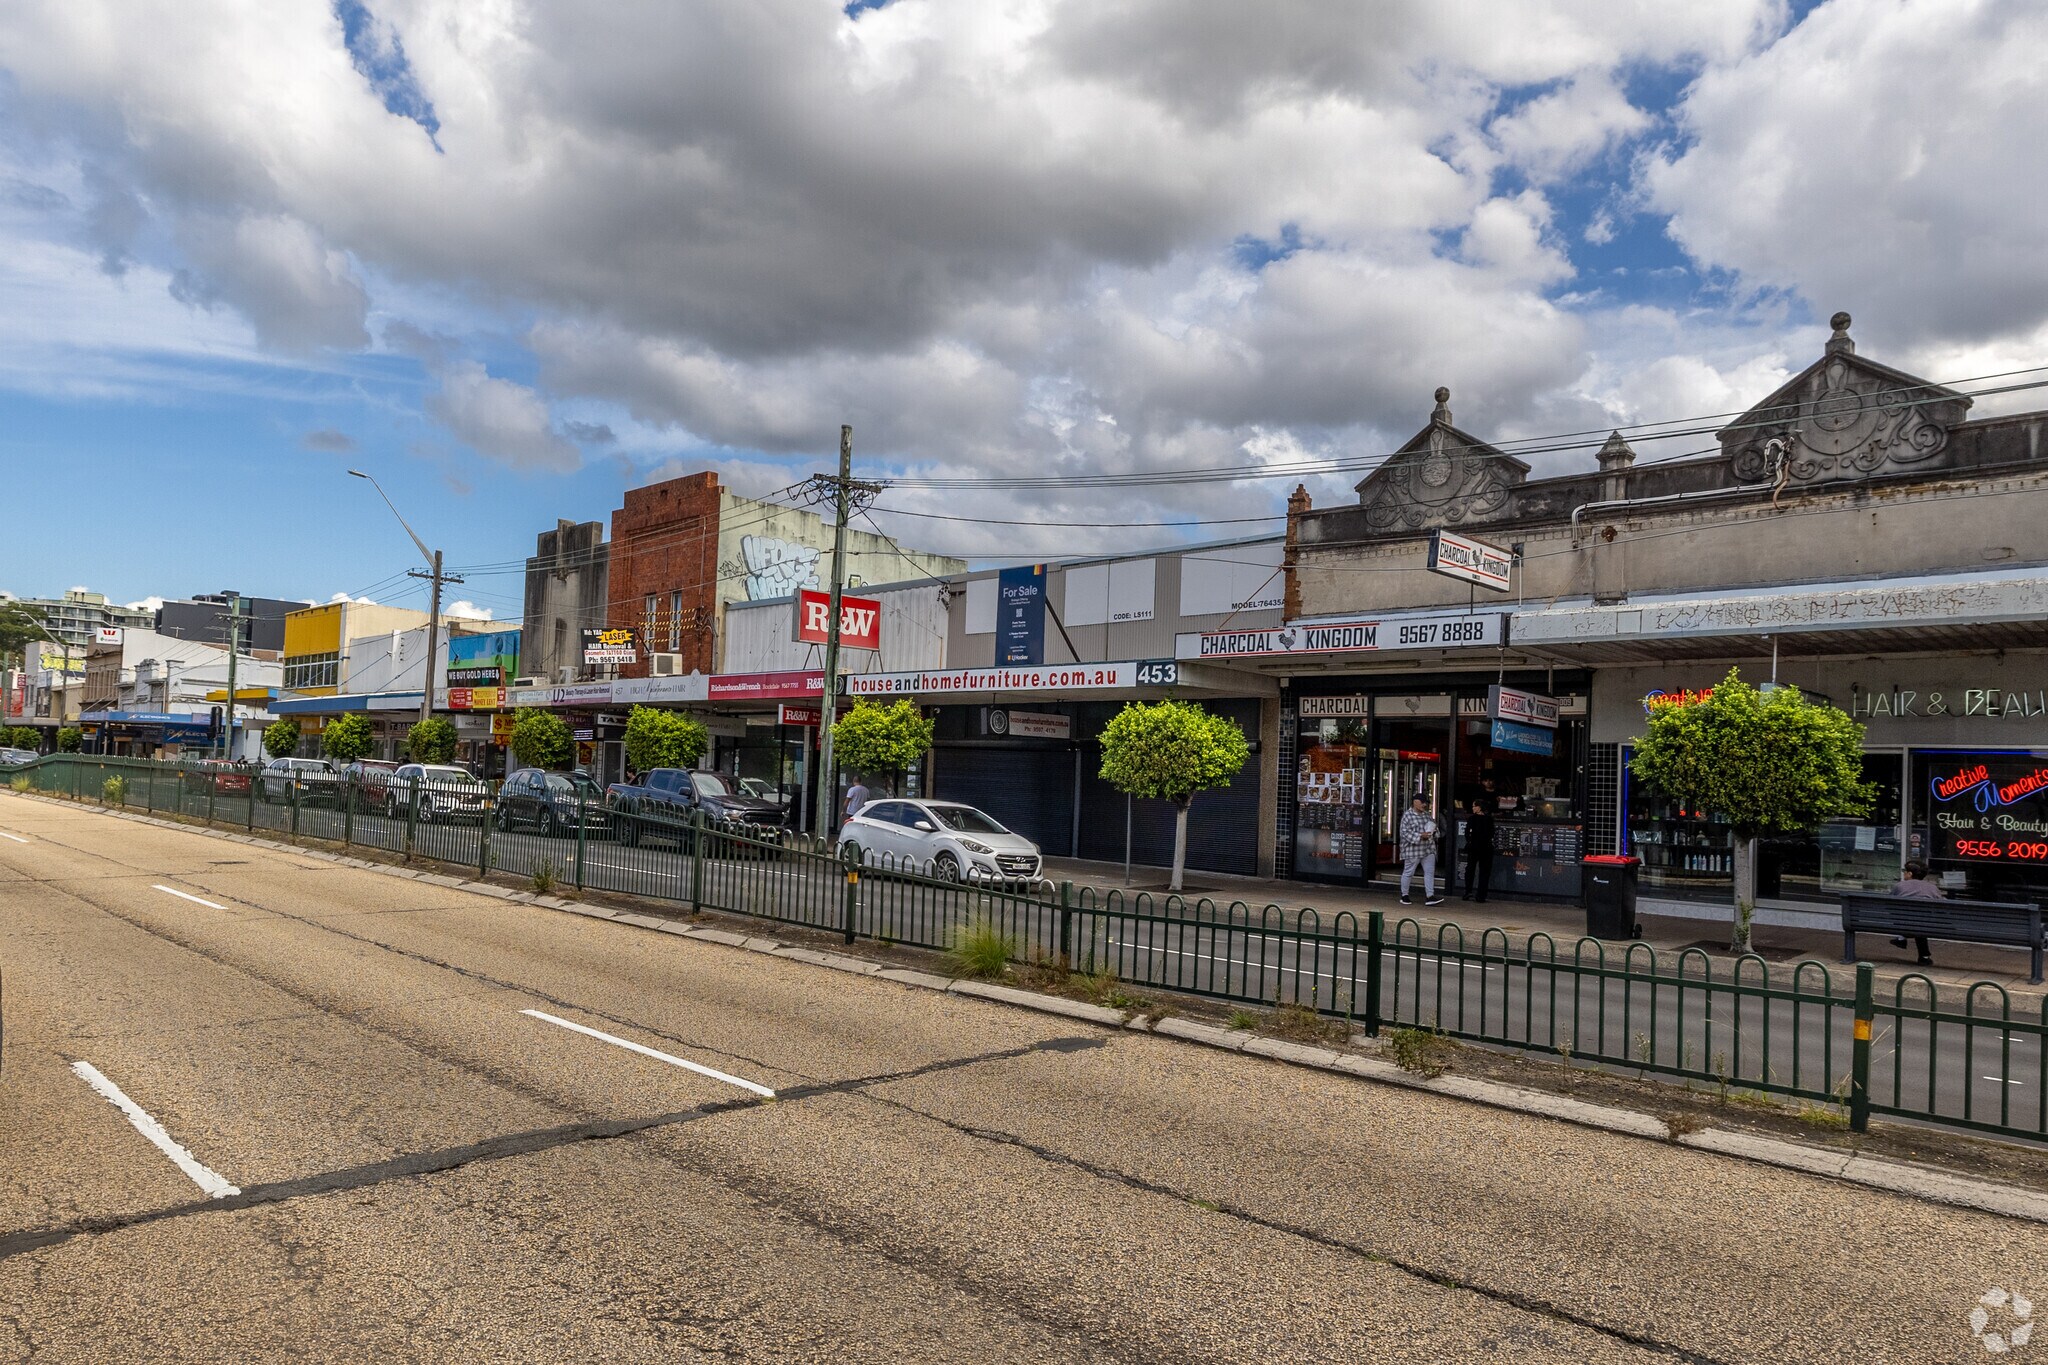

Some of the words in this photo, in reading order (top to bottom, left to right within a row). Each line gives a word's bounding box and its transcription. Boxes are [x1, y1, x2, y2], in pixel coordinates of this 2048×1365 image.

[1440, 543, 1470, 565] CHARCOAL
[1483, 557, 1508, 579] KINGDOM
[1003, 588, 1017, 598] For
[1018, 585, 1038, 597] Sale
[604, 632, 626, 640] LASER
[1201, 632, 1273, 655] CHARCOAL
[1305, 627, 1377, 650] KINGDOM
[1400, 626, 1437, 644] 9567
[1442, 622, 1484, 642] 8888
[448, 671, 456, 680] WE
[456, 670, 466, 680] BUY
[466, 669, 481, 679] GOLD
[481, 669, 496, 678] HERE
[852, 670, 1117, 693] houseandhomefurniture.com.au
[1138, 664, 1177, 684] 453
[553, 688, 565, 702] U2
[1852, 691, 1918, 718] HAIR
[1926, 692, 1948, 715] &
[785, 710, 809, 721] R&W
[1302, 699, 1367, 714] CHARCOAL
[1501, 696, 1527, 713] CHARCOAL
[1536, 704, 1557, 719] KINGDOM
[1932, 765, 1990, 802] Creative
[1975, 769, 2048, 813] Moments
[1937, 813, 1974, 829] Hair
[1981, 817, 1991, 830] &
[1996, 814, 2048, 837] Beauty
[1957, 840, 2001, 857] 9556
[2008, 842, 2048, 859] 2019
